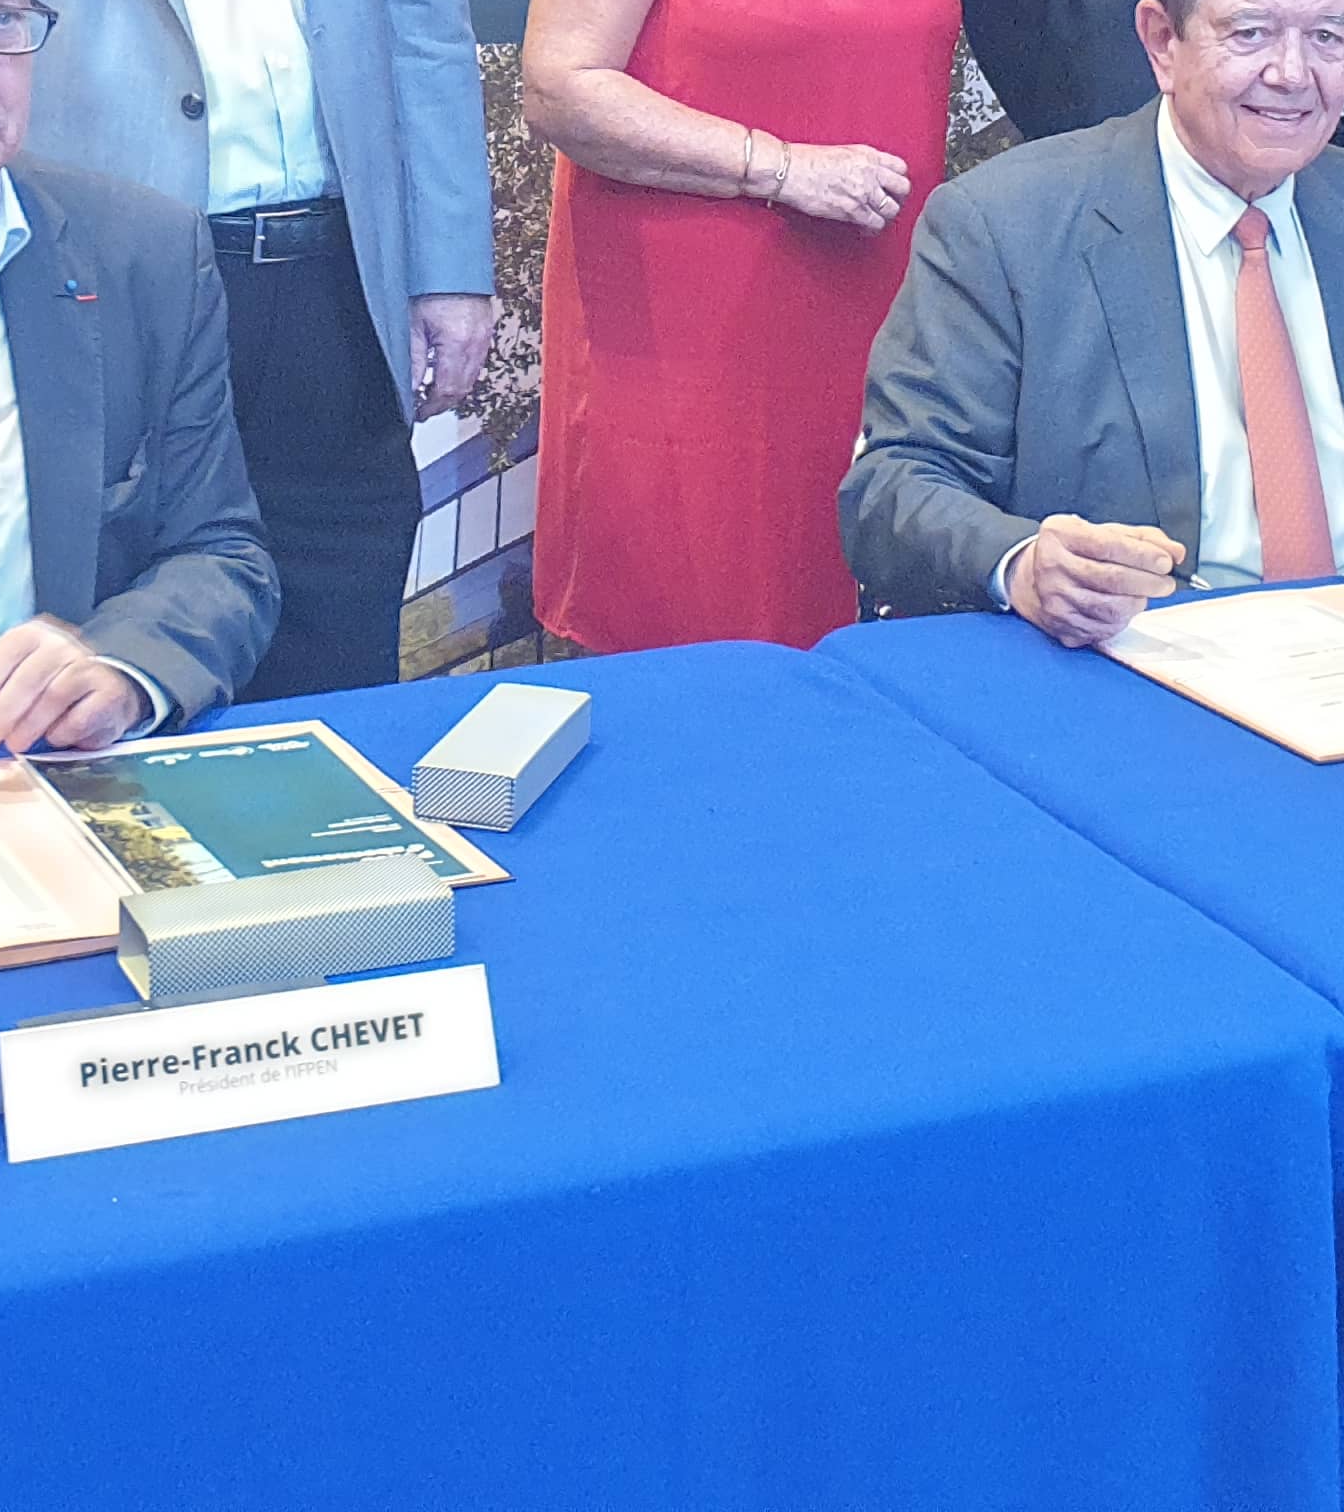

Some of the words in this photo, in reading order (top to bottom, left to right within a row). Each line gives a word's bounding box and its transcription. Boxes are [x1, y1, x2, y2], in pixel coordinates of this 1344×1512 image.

[80, 1031, 302, 1088] Pierre-Franck
[311, 1012, 425, 1052] CHEVET
[179, 1072, 256, 1096] Président
[260, 1067, 281, 1083] de
